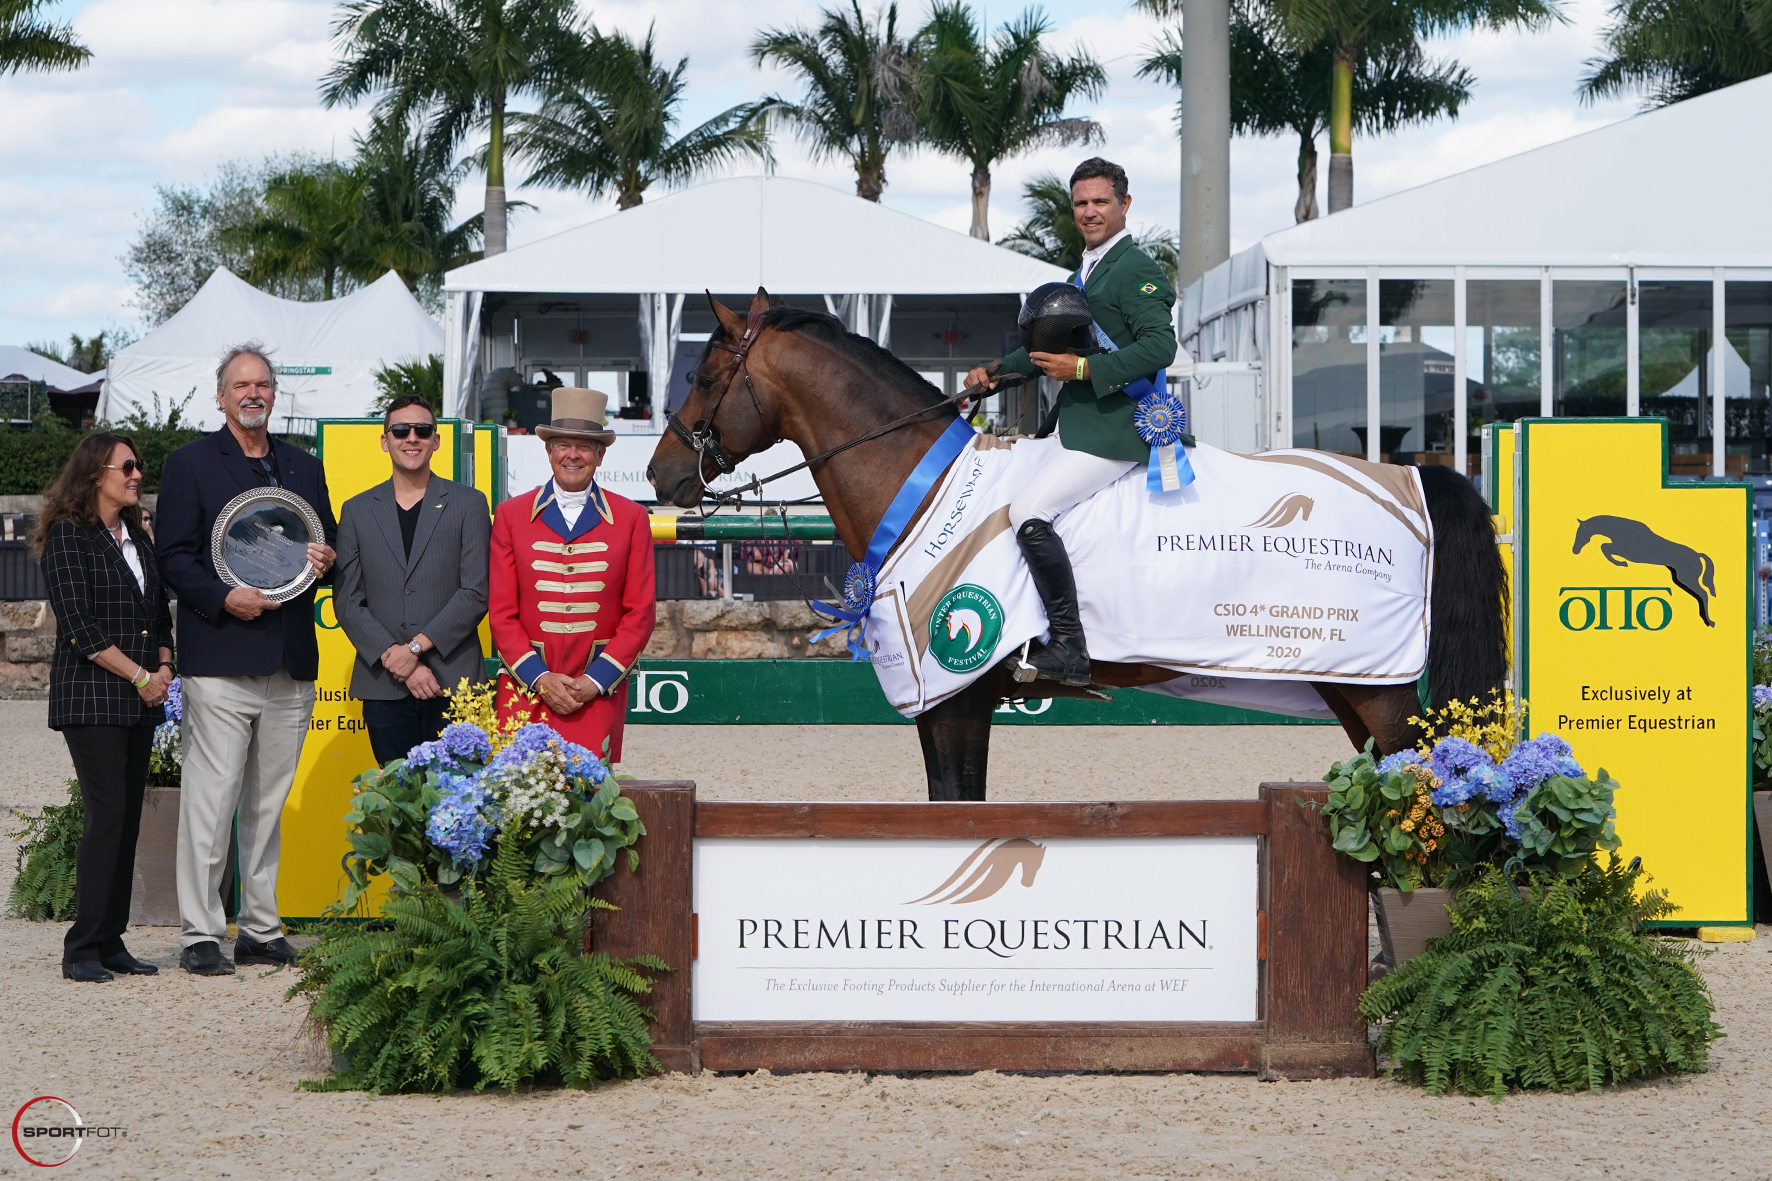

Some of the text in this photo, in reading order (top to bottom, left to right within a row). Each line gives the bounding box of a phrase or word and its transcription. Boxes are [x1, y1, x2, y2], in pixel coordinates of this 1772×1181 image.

[595, 471, 648, 482] PREMIE
[1157, 534, 1256, 553] PREMIER
[1304, 559, 1392, 583] The Arena Company
[933, 591, 997, 637] WINTER EQUESTRIAN
[1213, 603, 1247, 617] CSIO
[1268, 605, 1324, 620] GRAND
[1327, 607, 1360, 622] PRIX
[1559, 587, 1673, 631] OTTO
[1225, 624, 1346, 642] WELLINGTON, FL
[947, 648, 988, 666] FESTIVAL
[1265, 645, 1301, 659] 2020
[631, 671, 689, 714] TO
[1581, 685, 1693, 705] Exclusively at
[1558, 714, 1716, 734] Premier Equestrian
[738, 919, 926, 949] PREMIER
[766, 979, 1189, 995] The Exclusive Footing Products Supplier for the International Arena at WEF
